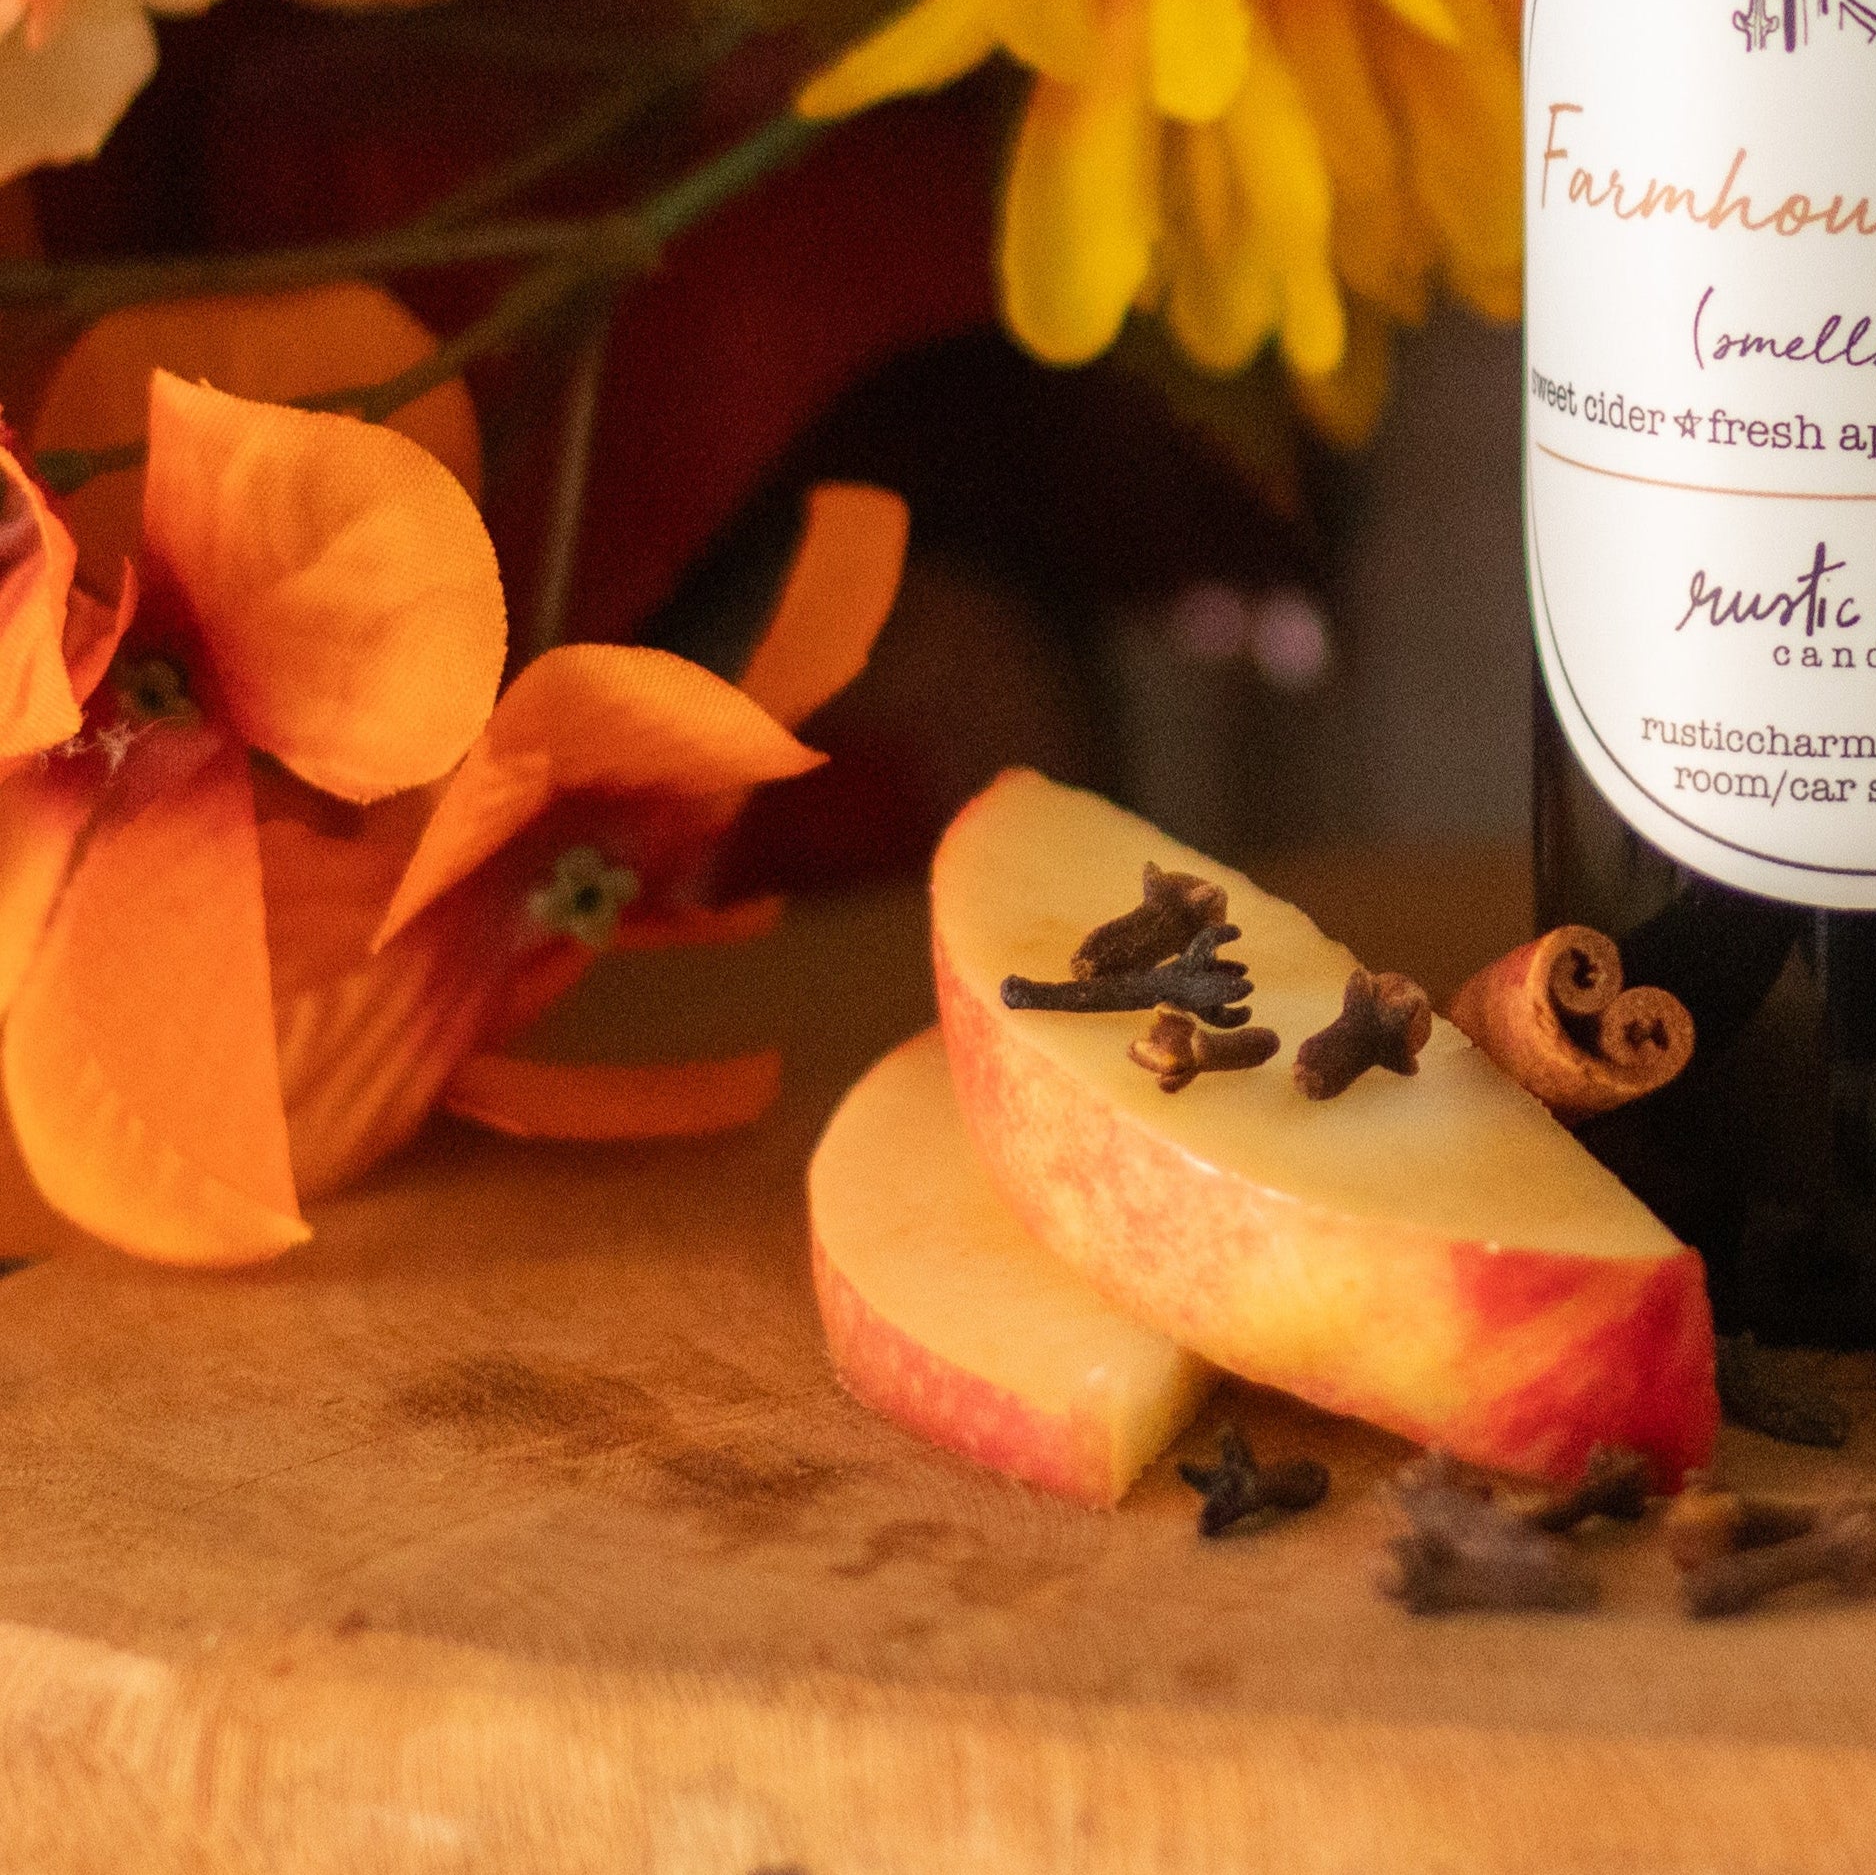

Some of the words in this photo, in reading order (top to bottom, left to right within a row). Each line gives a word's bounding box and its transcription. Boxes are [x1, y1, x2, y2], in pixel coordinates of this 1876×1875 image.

[1583, 390, 1666, 437] cider
[1707, 408, 1826, 451] fresh
[1674, 541, 1861, 637] rustic
[1673, 764, 1857, 807] room/car
